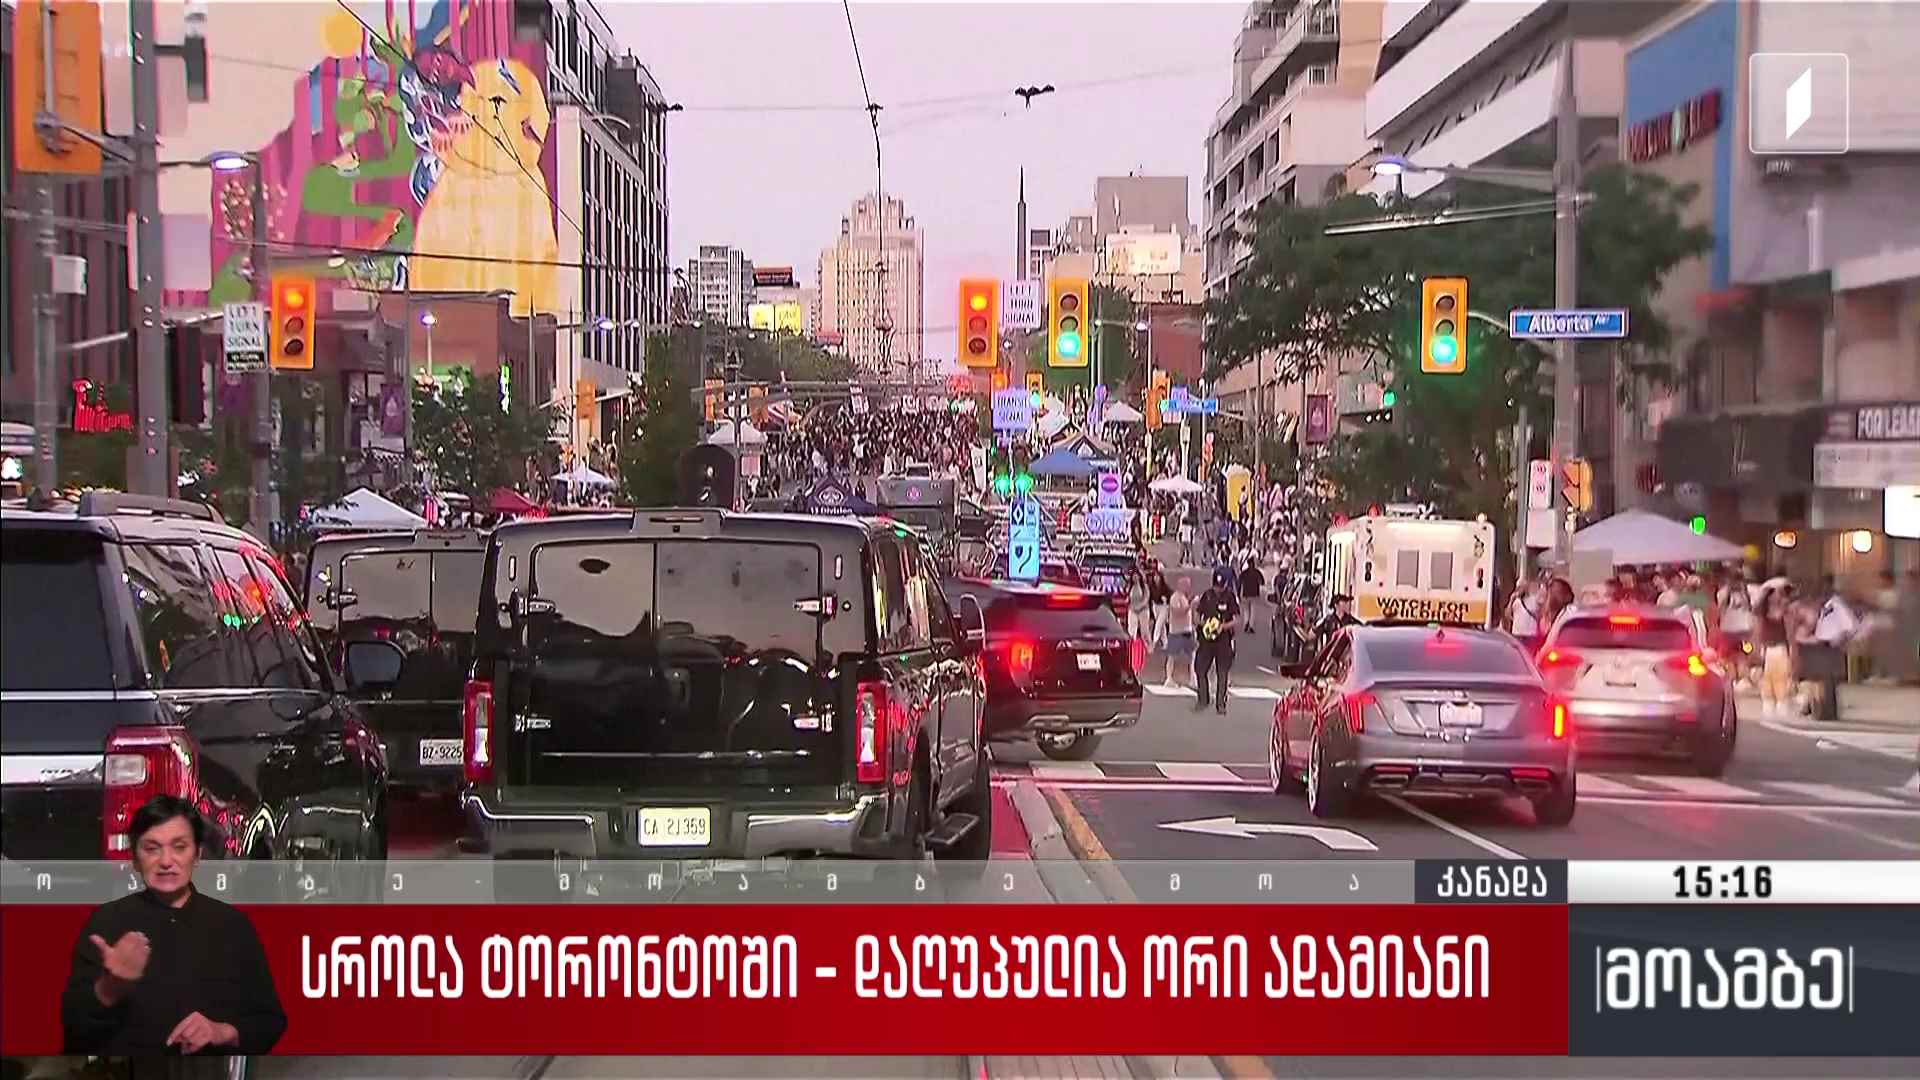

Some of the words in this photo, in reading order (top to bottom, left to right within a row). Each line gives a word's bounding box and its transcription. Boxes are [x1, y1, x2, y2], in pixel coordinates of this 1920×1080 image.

[1005, 313, 1034, 323] SIGNAL
[1528, 314, 1592, 333] Alberta
[1857, 407, 1883, 440] FOR
[821, 506, 853, 515] Division
[1377, 597, 1431, 610] WATCH
[1438, 601, 1469, 613] FOR
[644, 818, 658, 834] CA
